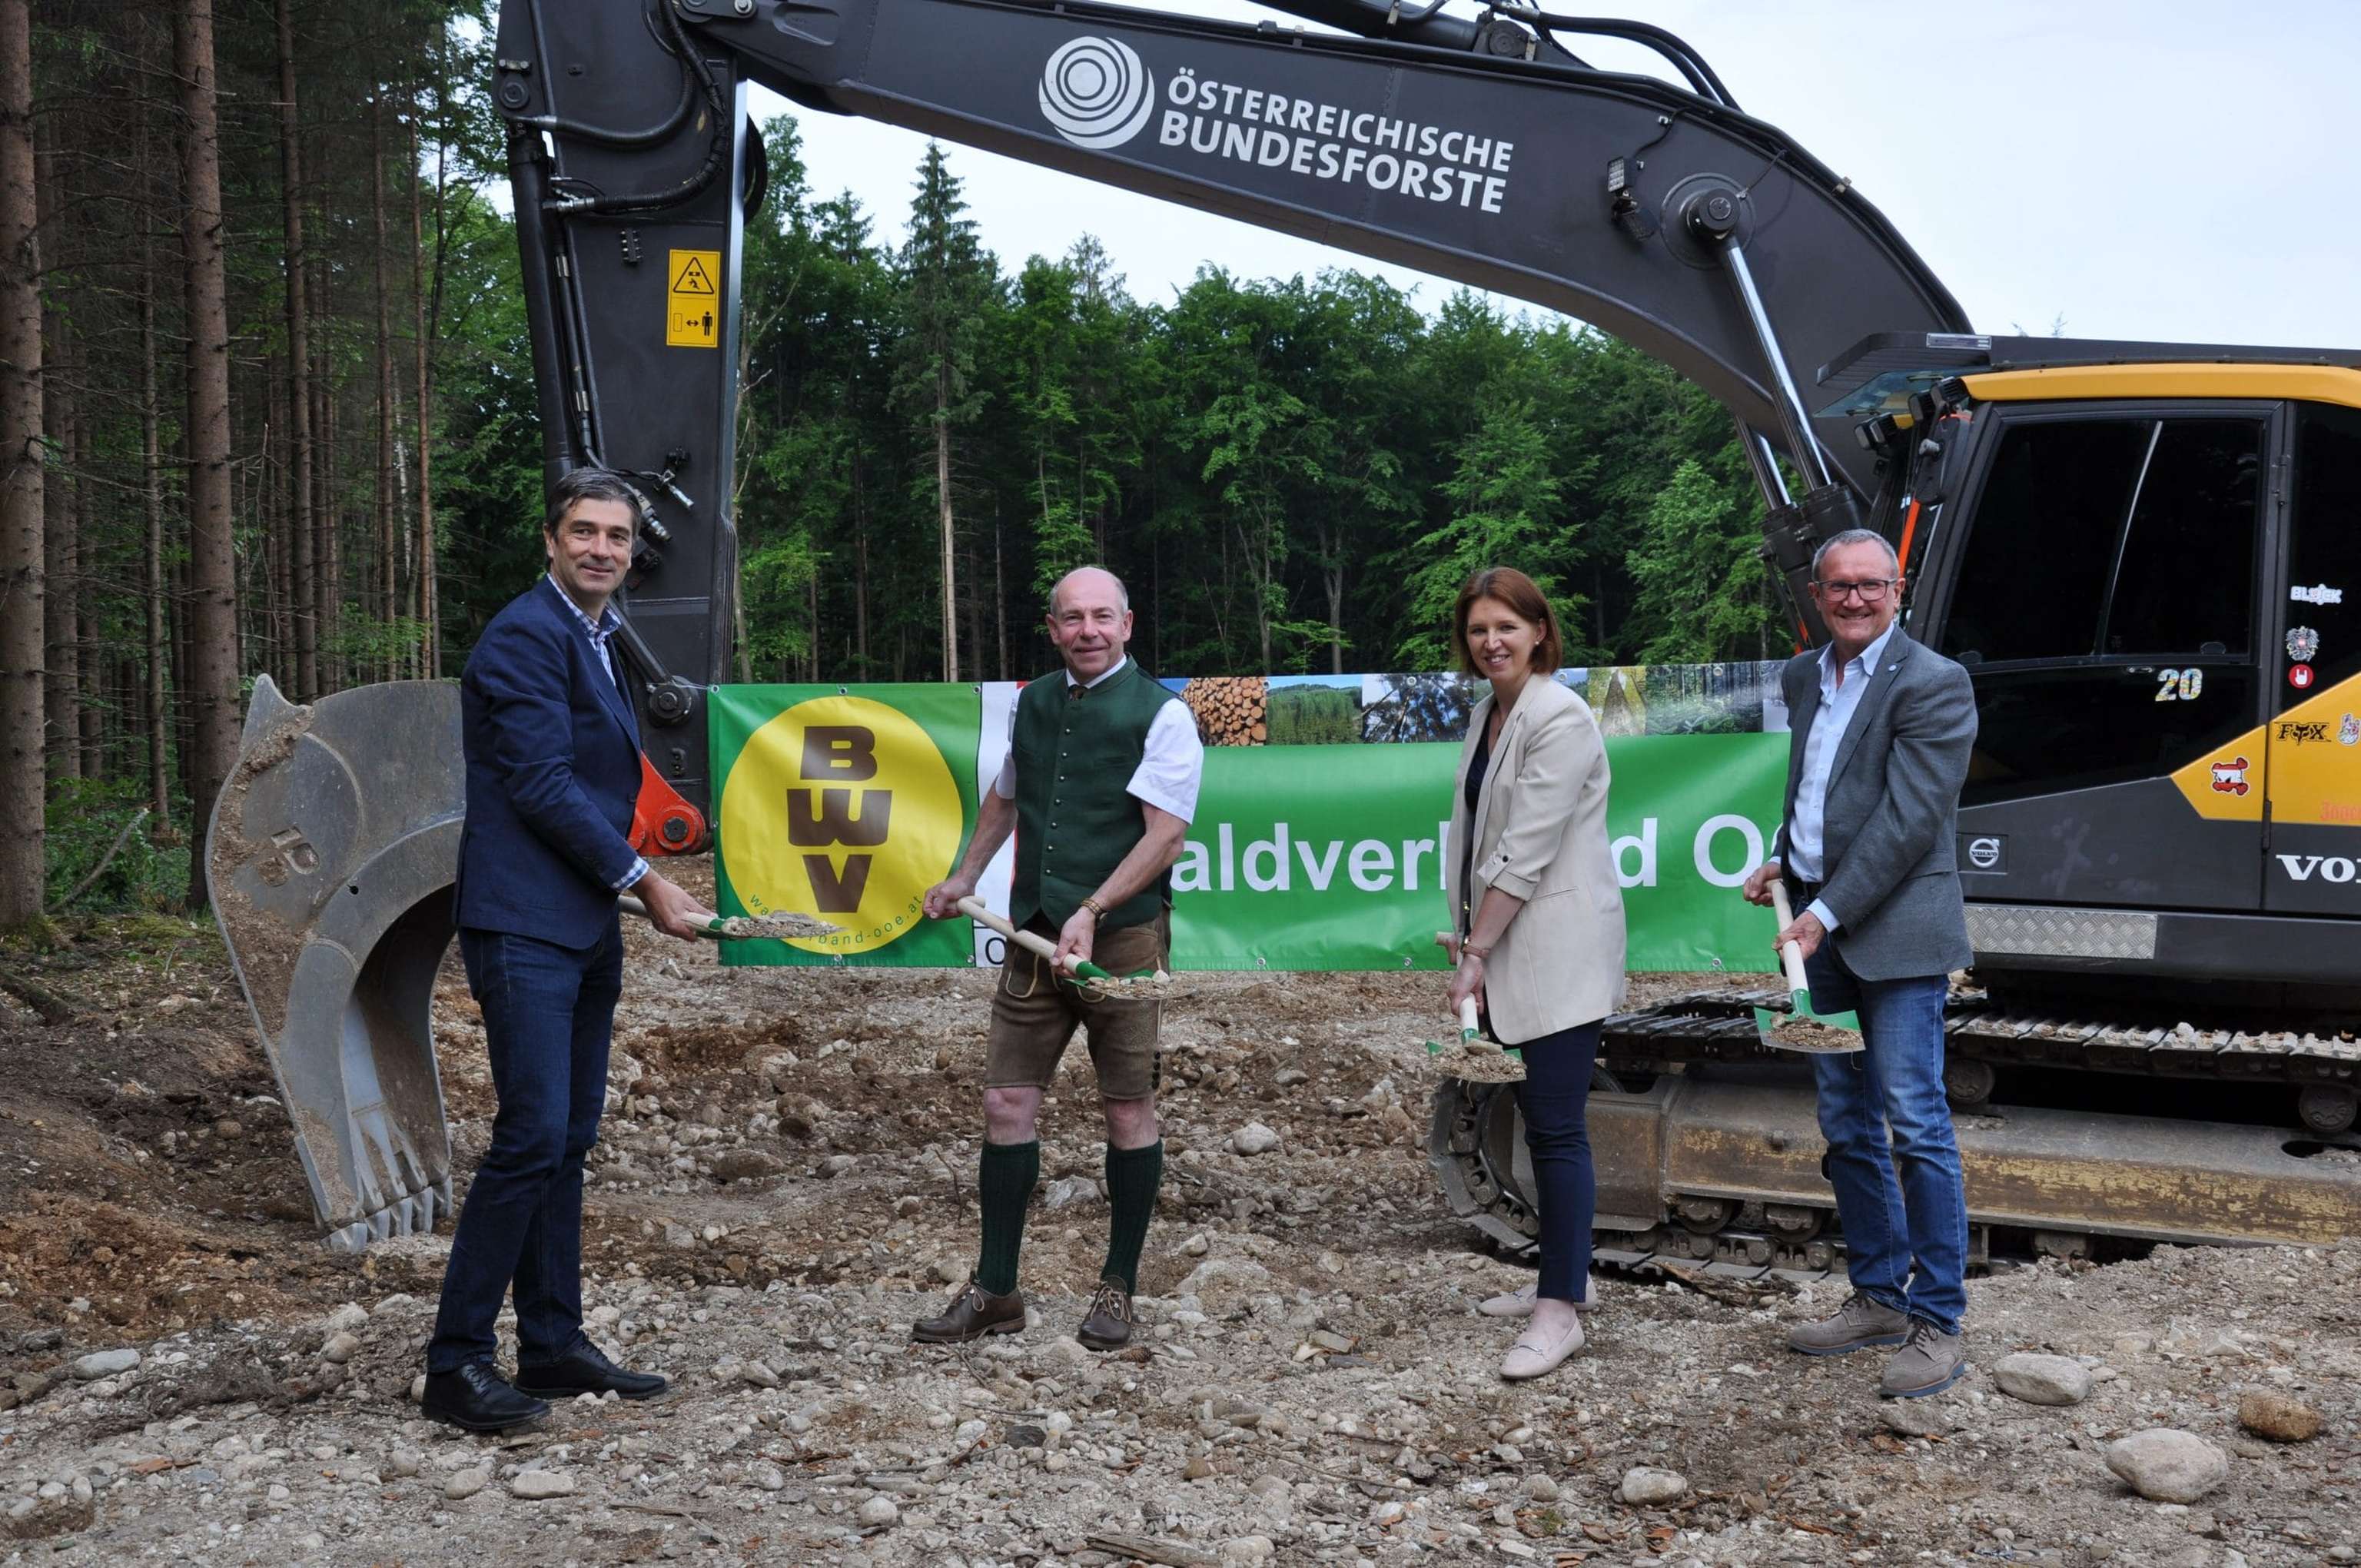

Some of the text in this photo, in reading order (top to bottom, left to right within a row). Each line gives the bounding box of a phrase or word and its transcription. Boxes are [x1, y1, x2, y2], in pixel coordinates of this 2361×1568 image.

[1167, 67, 1513, 173] ÖSTERREICHISCHE
[1159, 109, 1506, 214] BUNDESFORSTE
[2155, 667, 2203, 701] 20
[1169, 813, 1783, 892] aldverd O
[2276, 854, 2361, 884] VO
[749, 894, 922, 945] waband-ooe.at
[985, 937, 1006, 965] O
